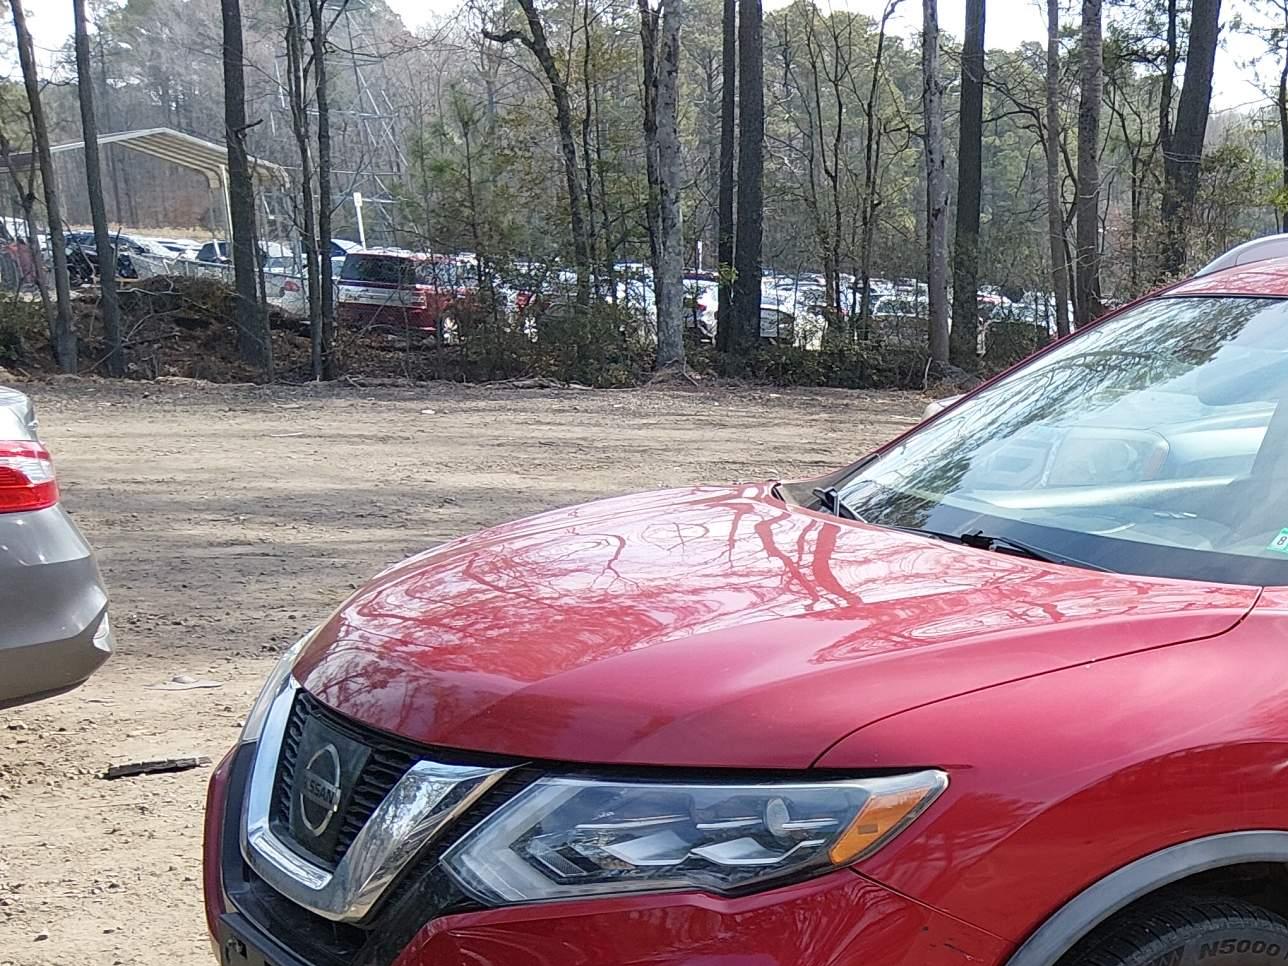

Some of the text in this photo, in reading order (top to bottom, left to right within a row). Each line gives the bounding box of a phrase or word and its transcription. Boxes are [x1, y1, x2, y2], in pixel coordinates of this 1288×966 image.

[1277, 536, 1287, 546] 8
[303, 774, 335, 804] SSAN
[1199, 938, 1281, 960] N5000
